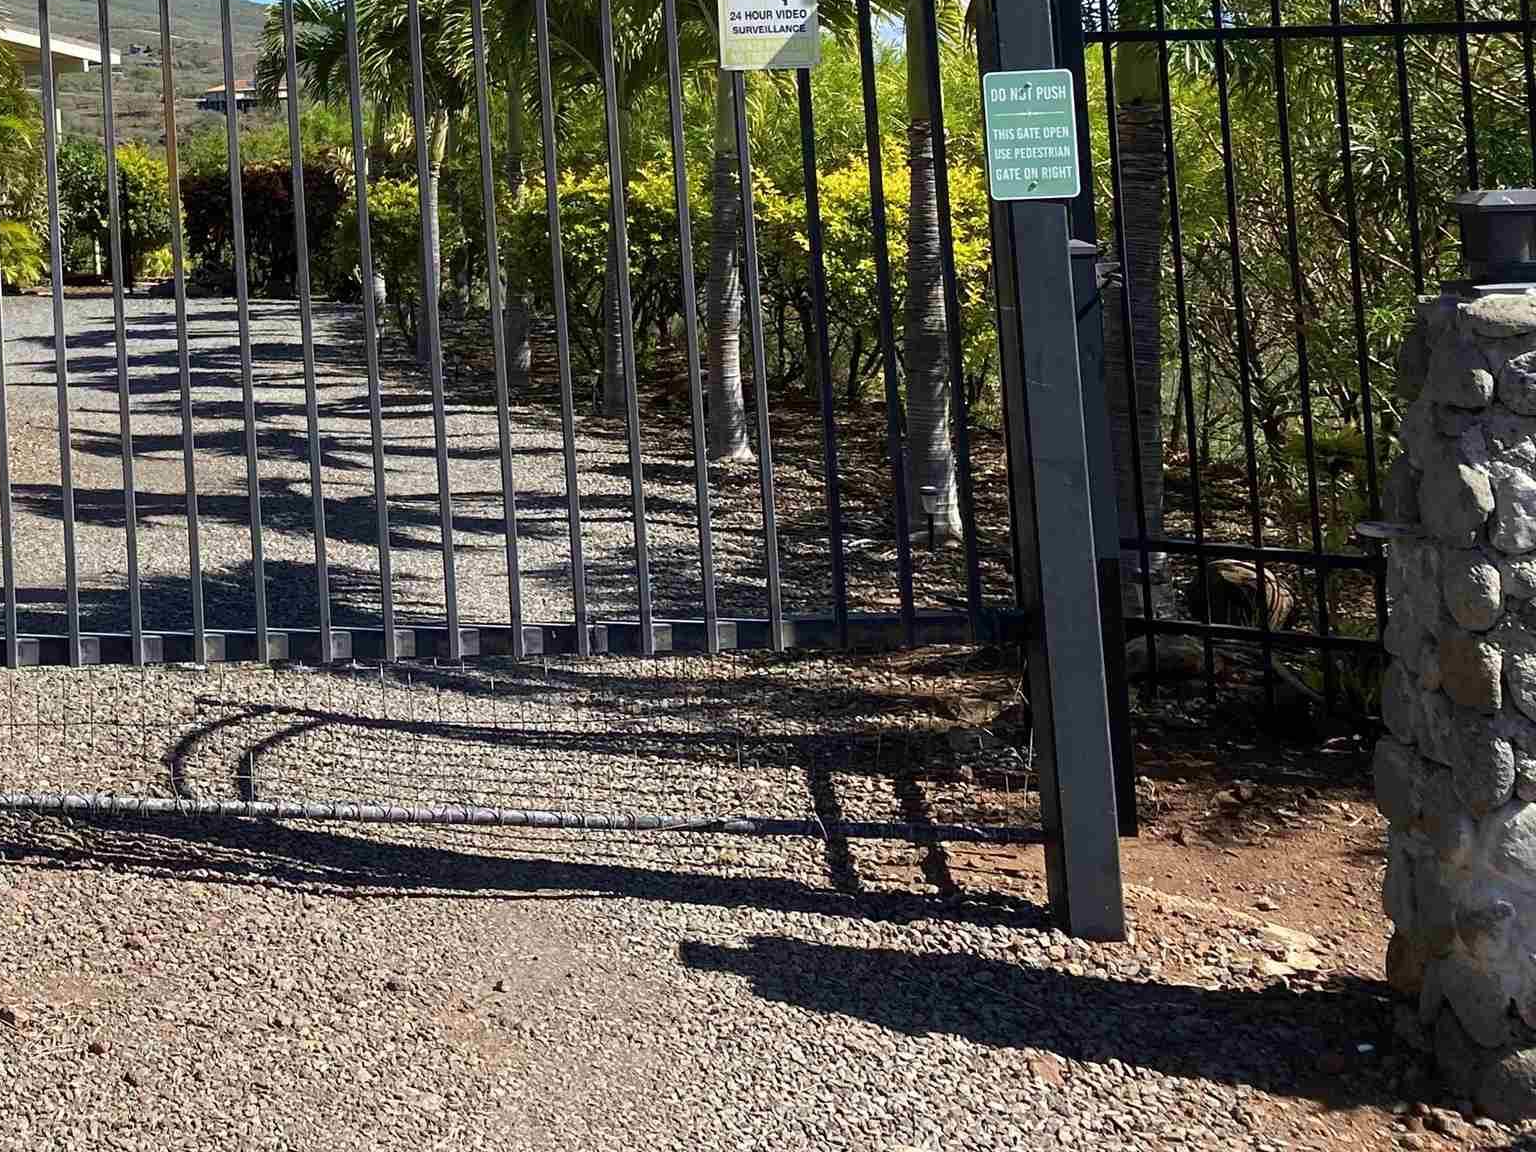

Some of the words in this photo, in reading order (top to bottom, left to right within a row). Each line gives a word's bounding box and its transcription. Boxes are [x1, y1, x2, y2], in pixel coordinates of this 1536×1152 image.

[729, 11, 742, 21] 24
[744, 9, 773, 21] HOUR
[776, 9, 807, 20] VIDEO
[732, 24, 807, 34] SURVEILLANCE
[991, 88, 1006, 102] DO
[1010, 87, 1032, 101] NOT
[1036, 85, 1066, 101] PUSH
[992, 127, 1015, 141] THIS
[1016, 127, 1041, 140] GATE
[1043, 125, 1069, 138] OPEN
[994, 147, 1013, 160] USE
[1014, 145, 1070, 159] PEDESTRIAN
[995, 167, 1022, 181] GATE
[1024, 167, 1039, 179] ON
[1041, 165, 1073, 179] RIGHT
